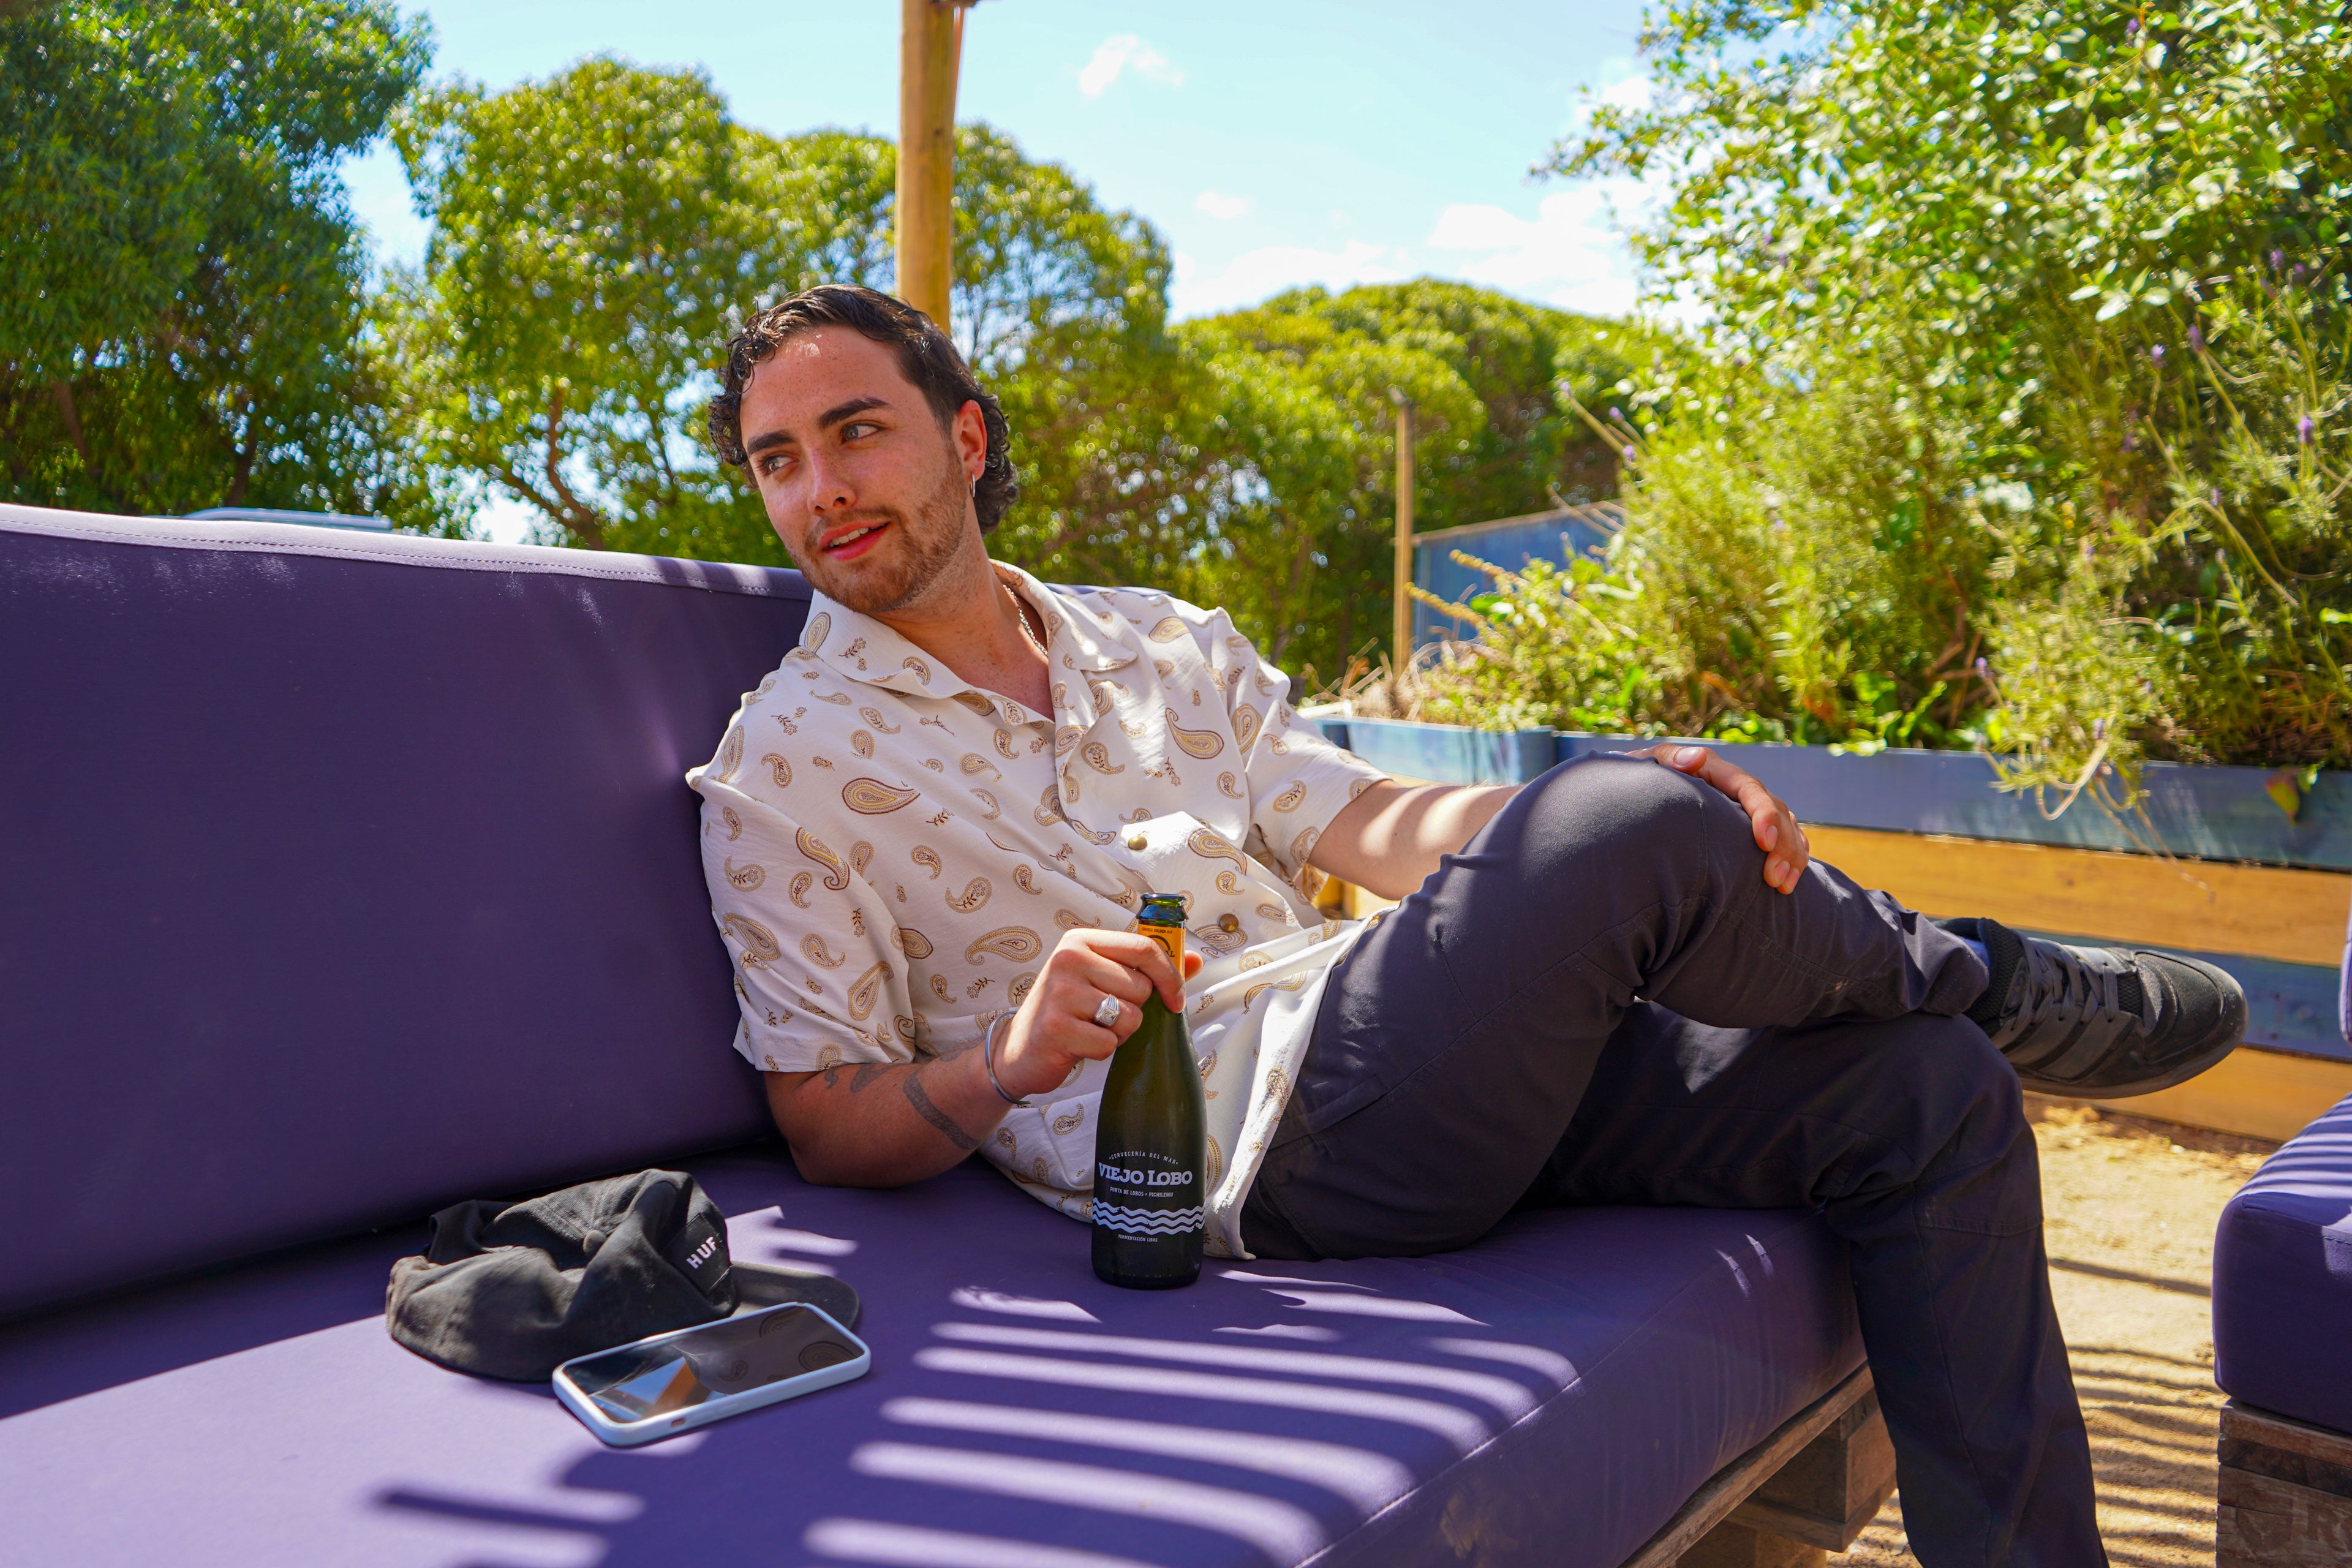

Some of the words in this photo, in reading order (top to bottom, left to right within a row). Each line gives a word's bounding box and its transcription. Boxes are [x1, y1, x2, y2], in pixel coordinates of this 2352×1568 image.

[1111, 1151, 1145, 1159] CERVECERÍA
[1163, 1156, 1176, 1164] MAR
[1098, 1162, 1144, 1185] VIEJO
[1147, 1170, 1193, 1186] LOBO
[686, 1236, 717, 1269] HUF
